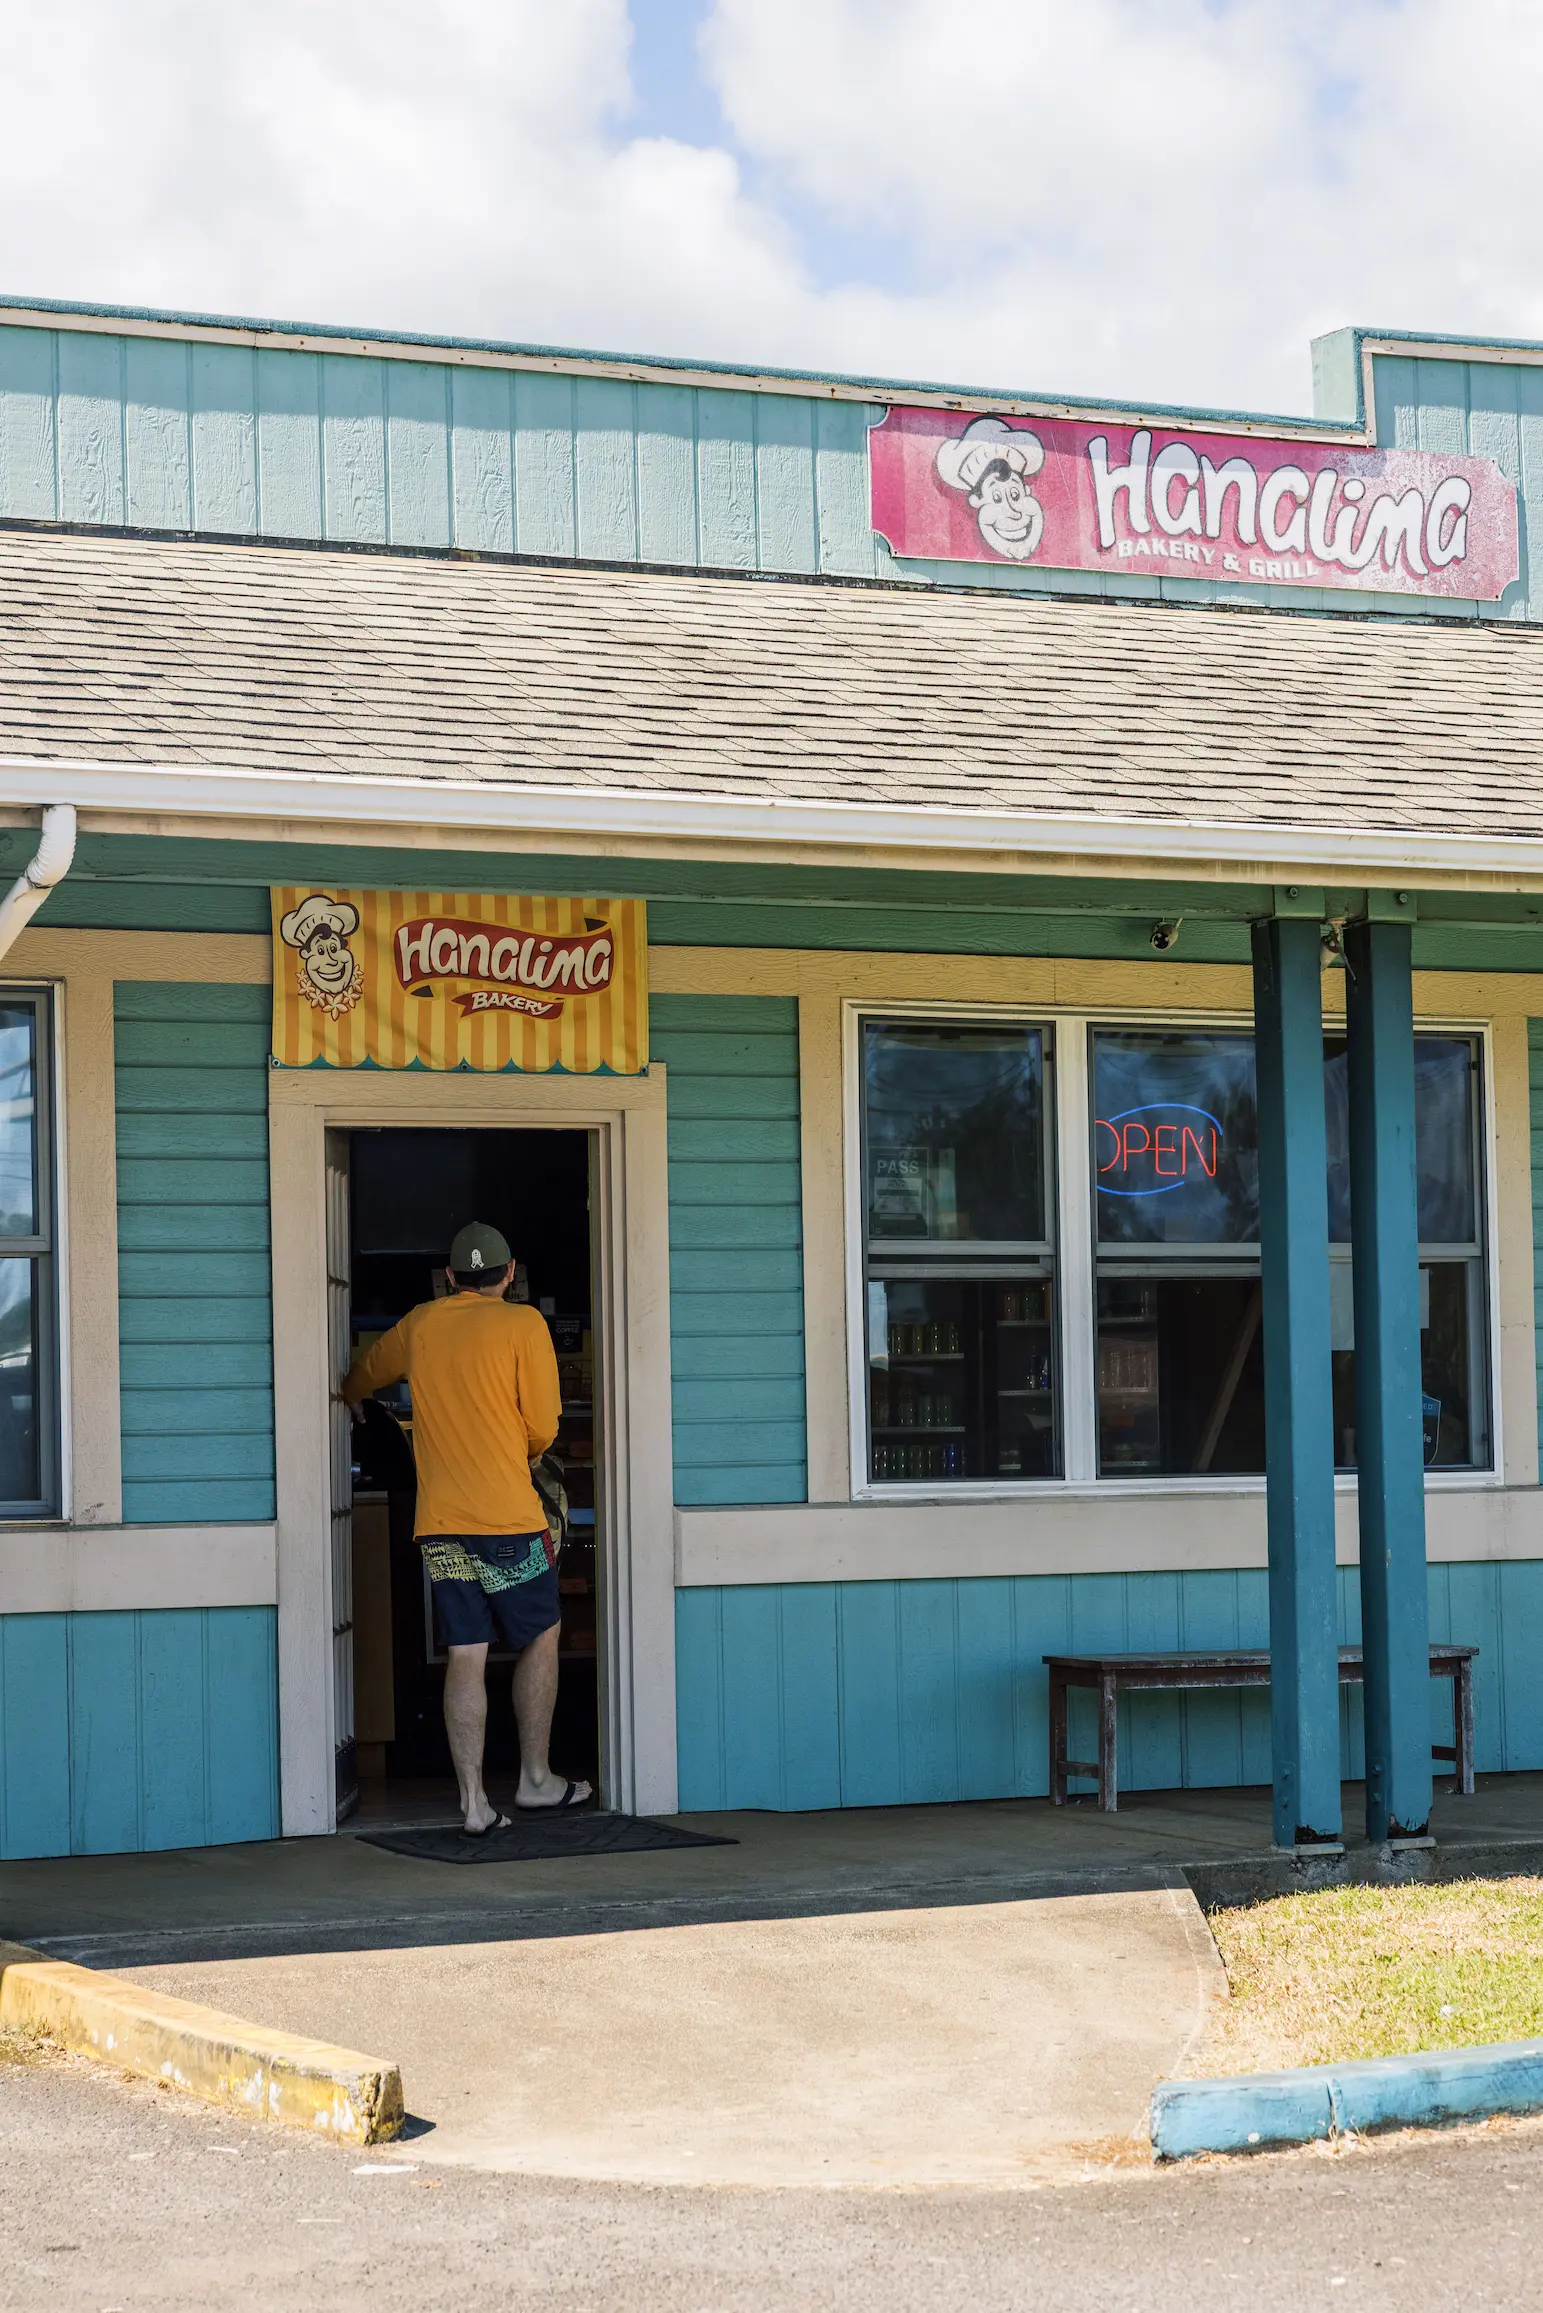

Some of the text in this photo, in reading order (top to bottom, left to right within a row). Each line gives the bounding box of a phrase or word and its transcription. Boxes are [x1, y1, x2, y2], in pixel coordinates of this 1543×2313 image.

[1087, 429, 1472, 576] Hanalima
[1117, 538, 1319, 579] BAKERY & GRILL
[397, 922, 612, 990] Hanalima
[471, 991, 553, 1016] BAKERY
[877, 1159, 920, 1174] PASS
